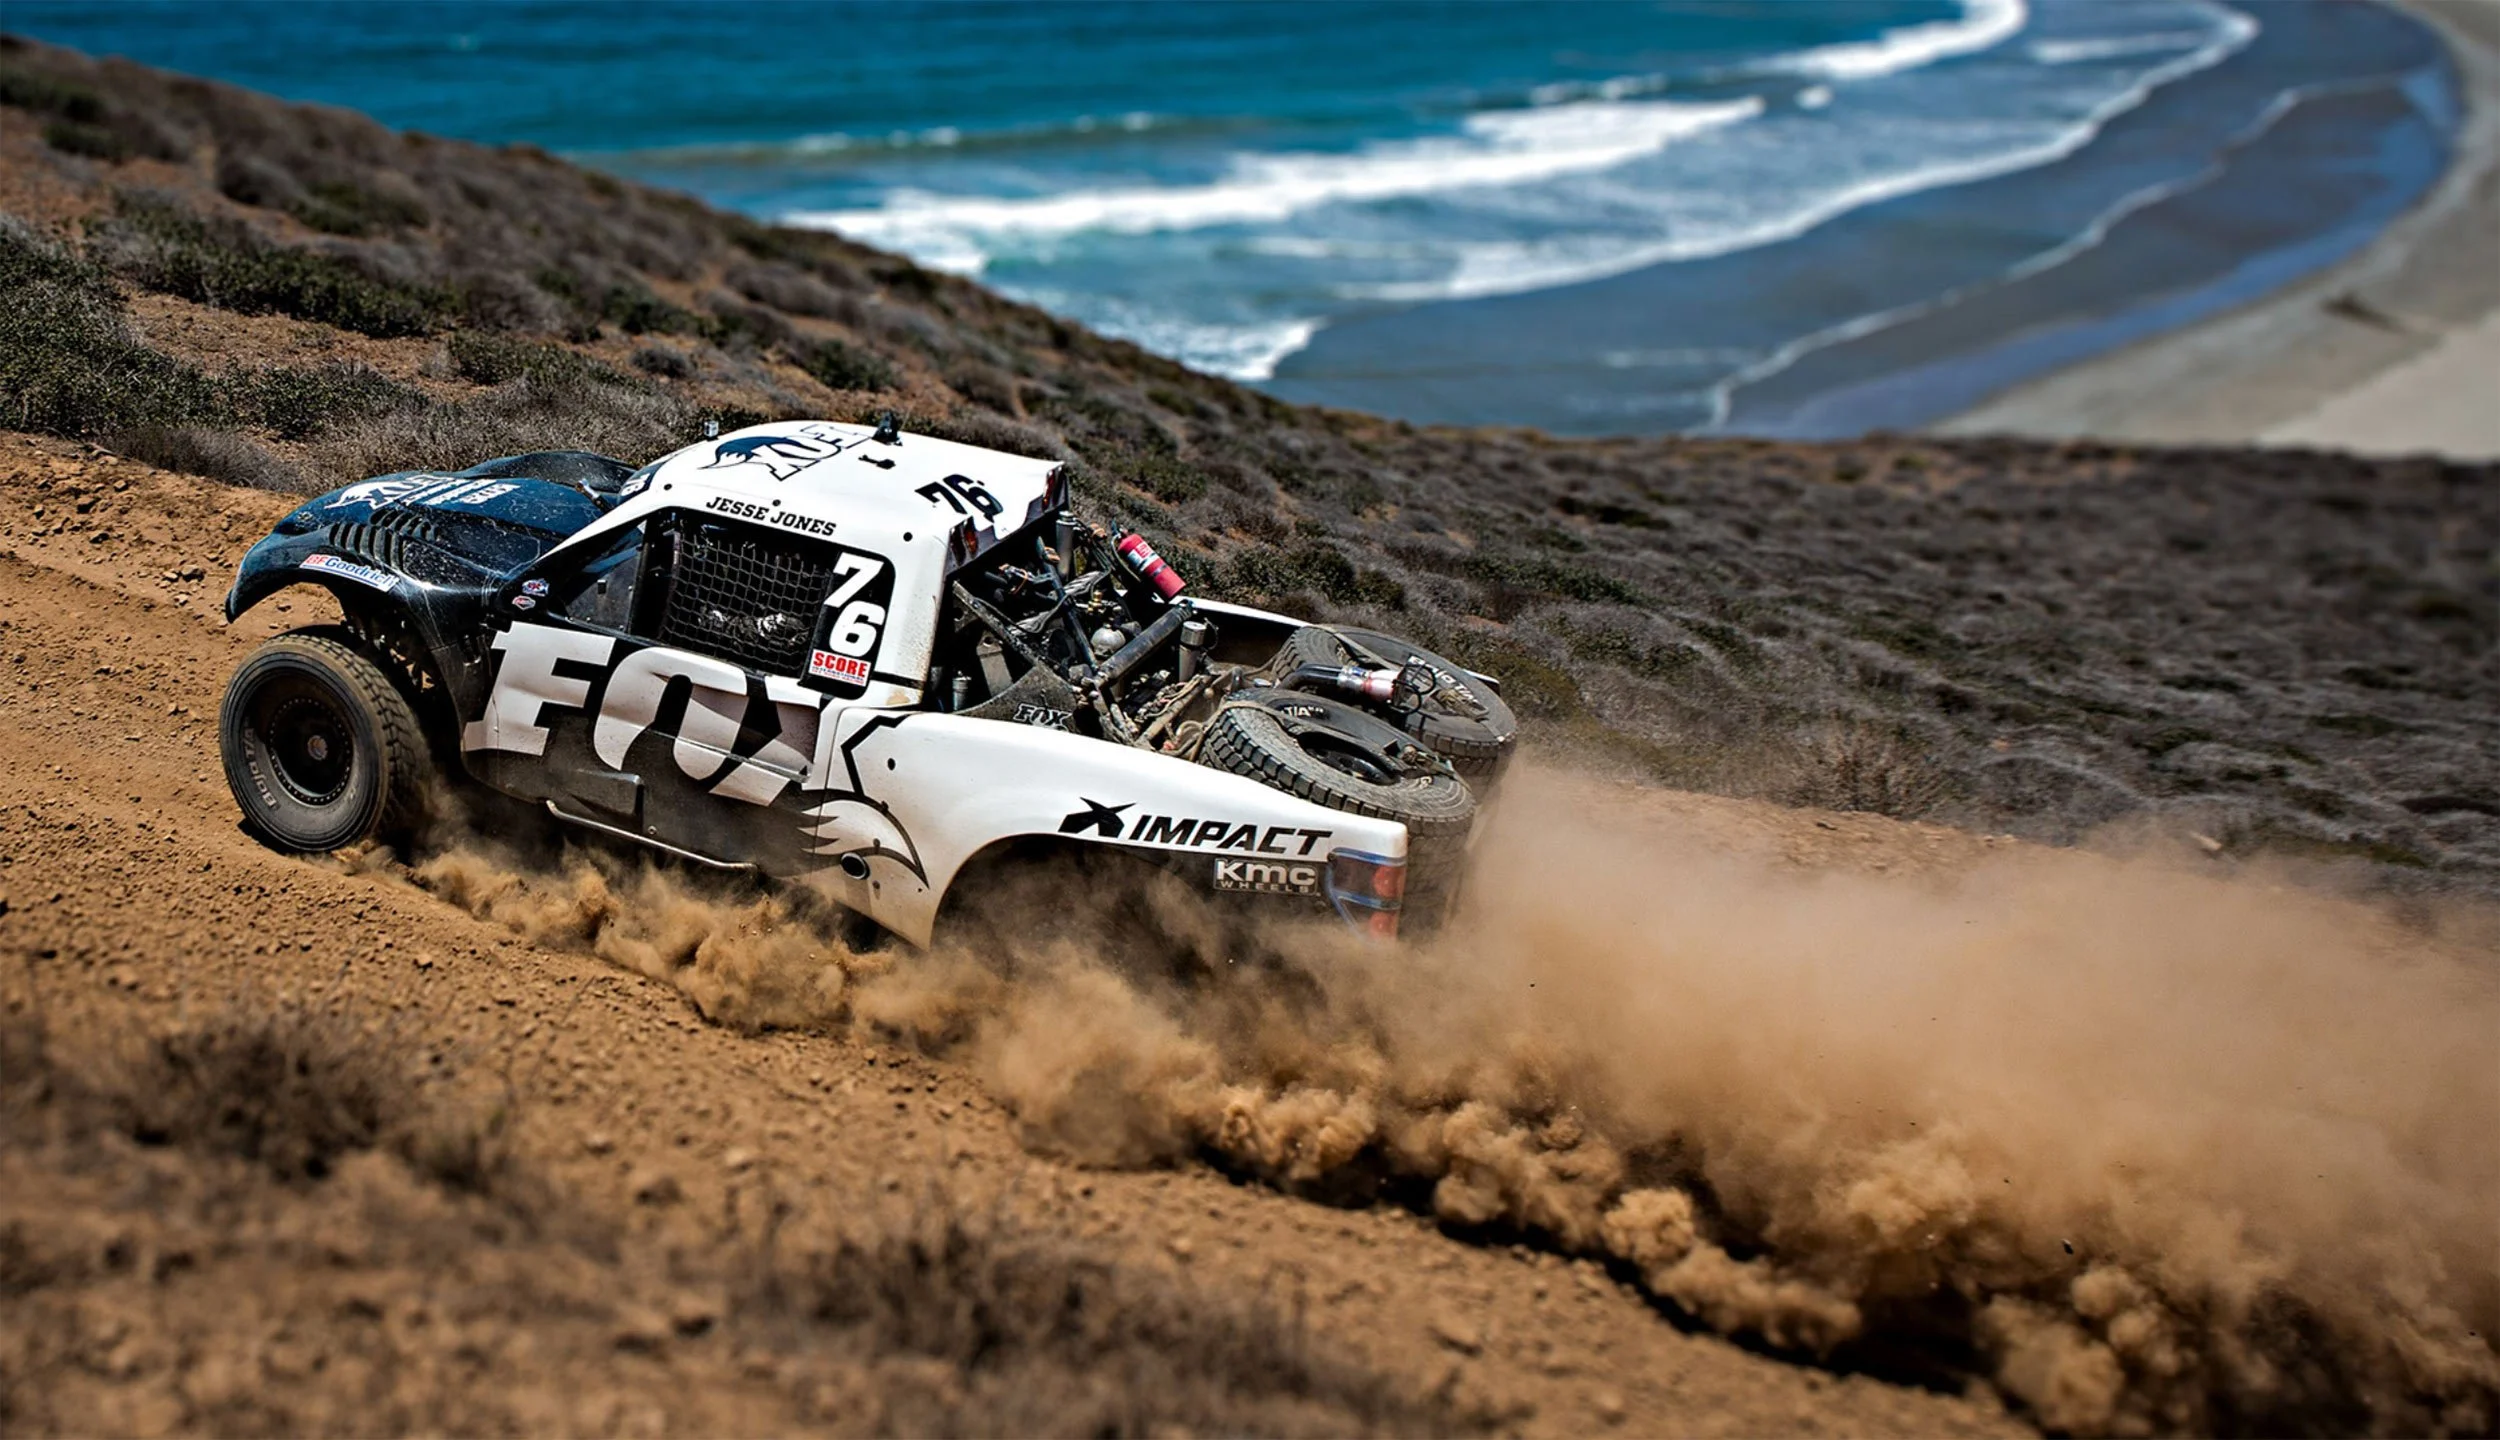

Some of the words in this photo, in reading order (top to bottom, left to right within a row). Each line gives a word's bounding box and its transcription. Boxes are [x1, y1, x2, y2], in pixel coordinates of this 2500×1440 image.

[706, 496, 769, 521] JESSE
[770, 511, 836, 537] JONES
[914, 473, 1003, 523] 76
[306, 556, 396, 587] BFGoodrich
[813, 652, 868, 678] SCORE
[461, 621, 912, 808] FOX
[1013, 703, 1073, 731] FOX
[249, 761, 278, 807] Baja
[1129, 815, 1332, 856] IMPACT
[1220, 881, 1309, 893] WHEELS
